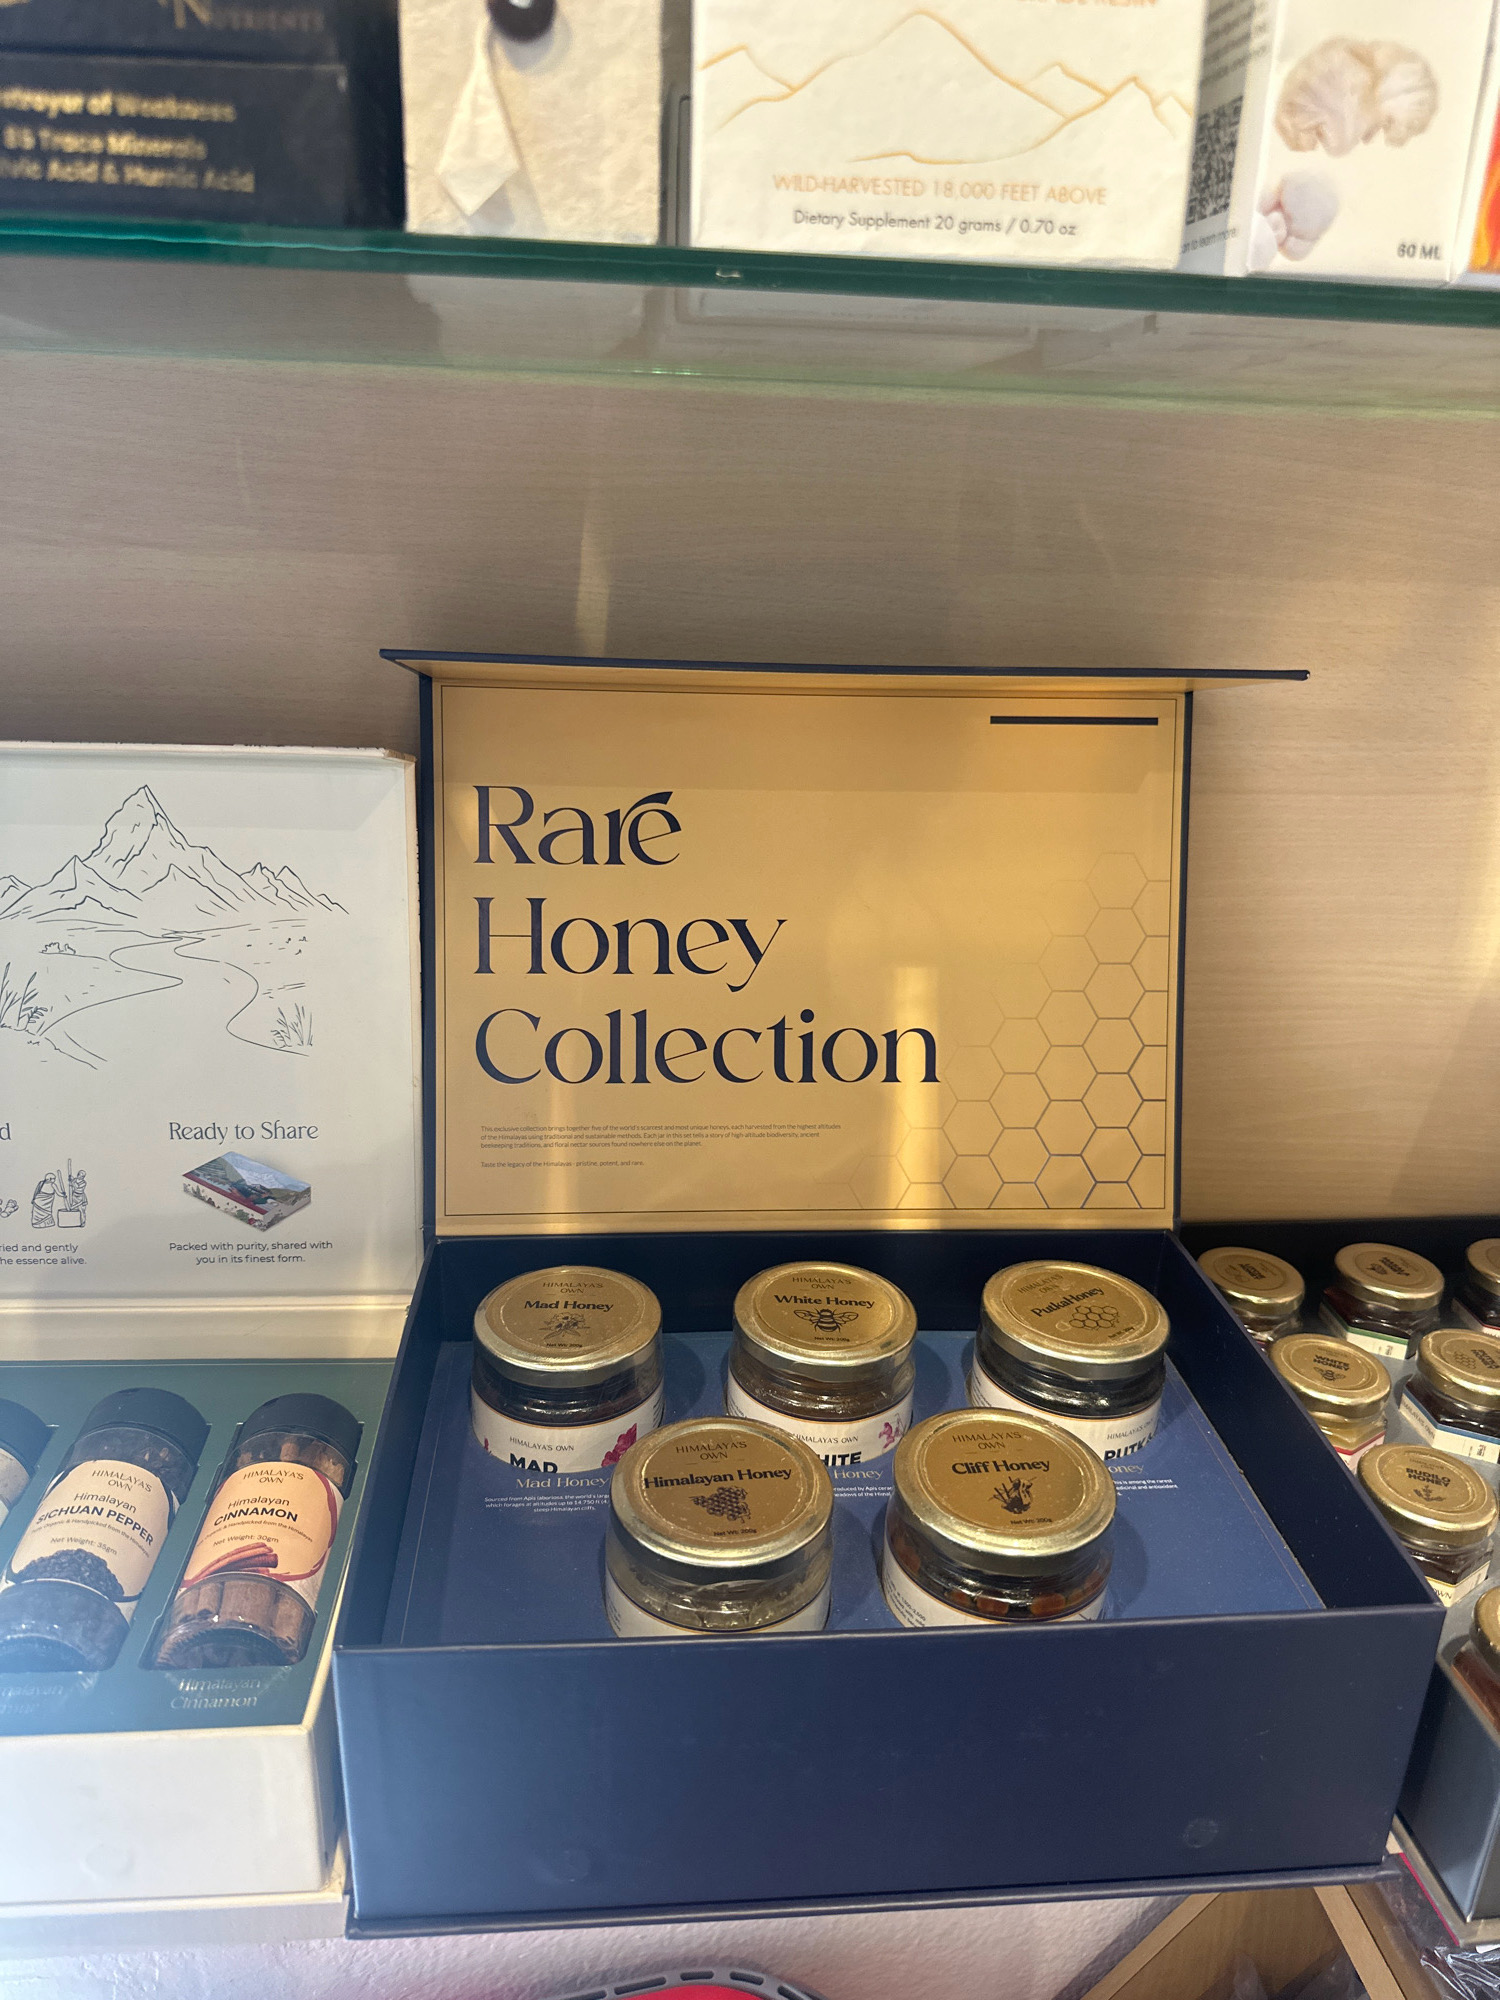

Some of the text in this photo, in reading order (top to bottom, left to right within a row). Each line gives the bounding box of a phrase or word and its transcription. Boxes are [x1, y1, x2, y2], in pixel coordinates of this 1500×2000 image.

[773, 174, 924, 196] WILD-HARVESTED
[1001, 183, 1039, 202] FEET
[1045, 186, 1107, 206] ABOVE
[793, 209, 1077, 236] Dietary Supplement 20 grams / 0.70 oz
[1418, 244, 1441, 260] ML
[472, 896, 787, 993] Honey
[475, 1008, 941, 1085] Collection
[169, 1120, 319, 1145] Ready to Share
[21, 1244, 42, 1252] and
[44, 1243, 78, 1253] gently
[169, 1241, 333, 1251] Packed with purity, shared with
[61, 1256, 87, 1265] alive.
[196, 1254, 306, 1265] you in its finest form.
[792, 1277, 851, 1285] HIMALAYA'S
[524, 1301, 614, 1312] Mad Honey
[774, 1295, 875, 1309] White Honey
[1315, 1354, 1349, 1367] WHITE
[510, 1436, 553, 1451] HIMALAYA'S
[952, 1431, 1021, 1443] HIMALAYA'S
[676, 1441, 747, 1453] HIMALAYA'S
[978, 1442, 1006, 1450] OWN
[700, 1451, 728, 1460] OWN
[818, 1451, 862, 1467] HITE
[510, 1453, 558, 1474] MAD
[952, 1460, 1050, 1474] Cliff Honey
[91, 1470, 152, 1493] HIMALAYA'S
[243, 1470, 304, 1480] HIMALAYA'S
[644, 1469, 792, 1488] Himalayan Honey
[834, 1469, 883, 1480] Honey
[1408, 1474, 1450, 1487] HONEY
[108, 1479, 133, 1492] OWN
[516, 1477, 610, 1488] Mad Honey
[74, 1492, 137, 1514] Himalayan
[227, 1495, 290, 1510] Himalayan
[213, 1507, 298, 1527] CINNAMON
[229, 1520, 262, 1528] Handpicked
[36, 1505, 154, 1546] SICHUAN PEPPER
[72, 1518, 107, 1528] Handpicked
[108, 1524, 121, 1534] from
[121, 1531, 129, 1539] the
[67, 1537, 96, 1547] Weight:
[97, 1540, 118, 1556] 35gm
[213, 1538, 225, 1547] Net
[227, 1534, 255, 1543] Weight:
[257, 1534, 279, 1543] 30gm
[178, 1678, 261, 1692] Himalayan
[171, 1695, 258, 1710] Cinnamon
